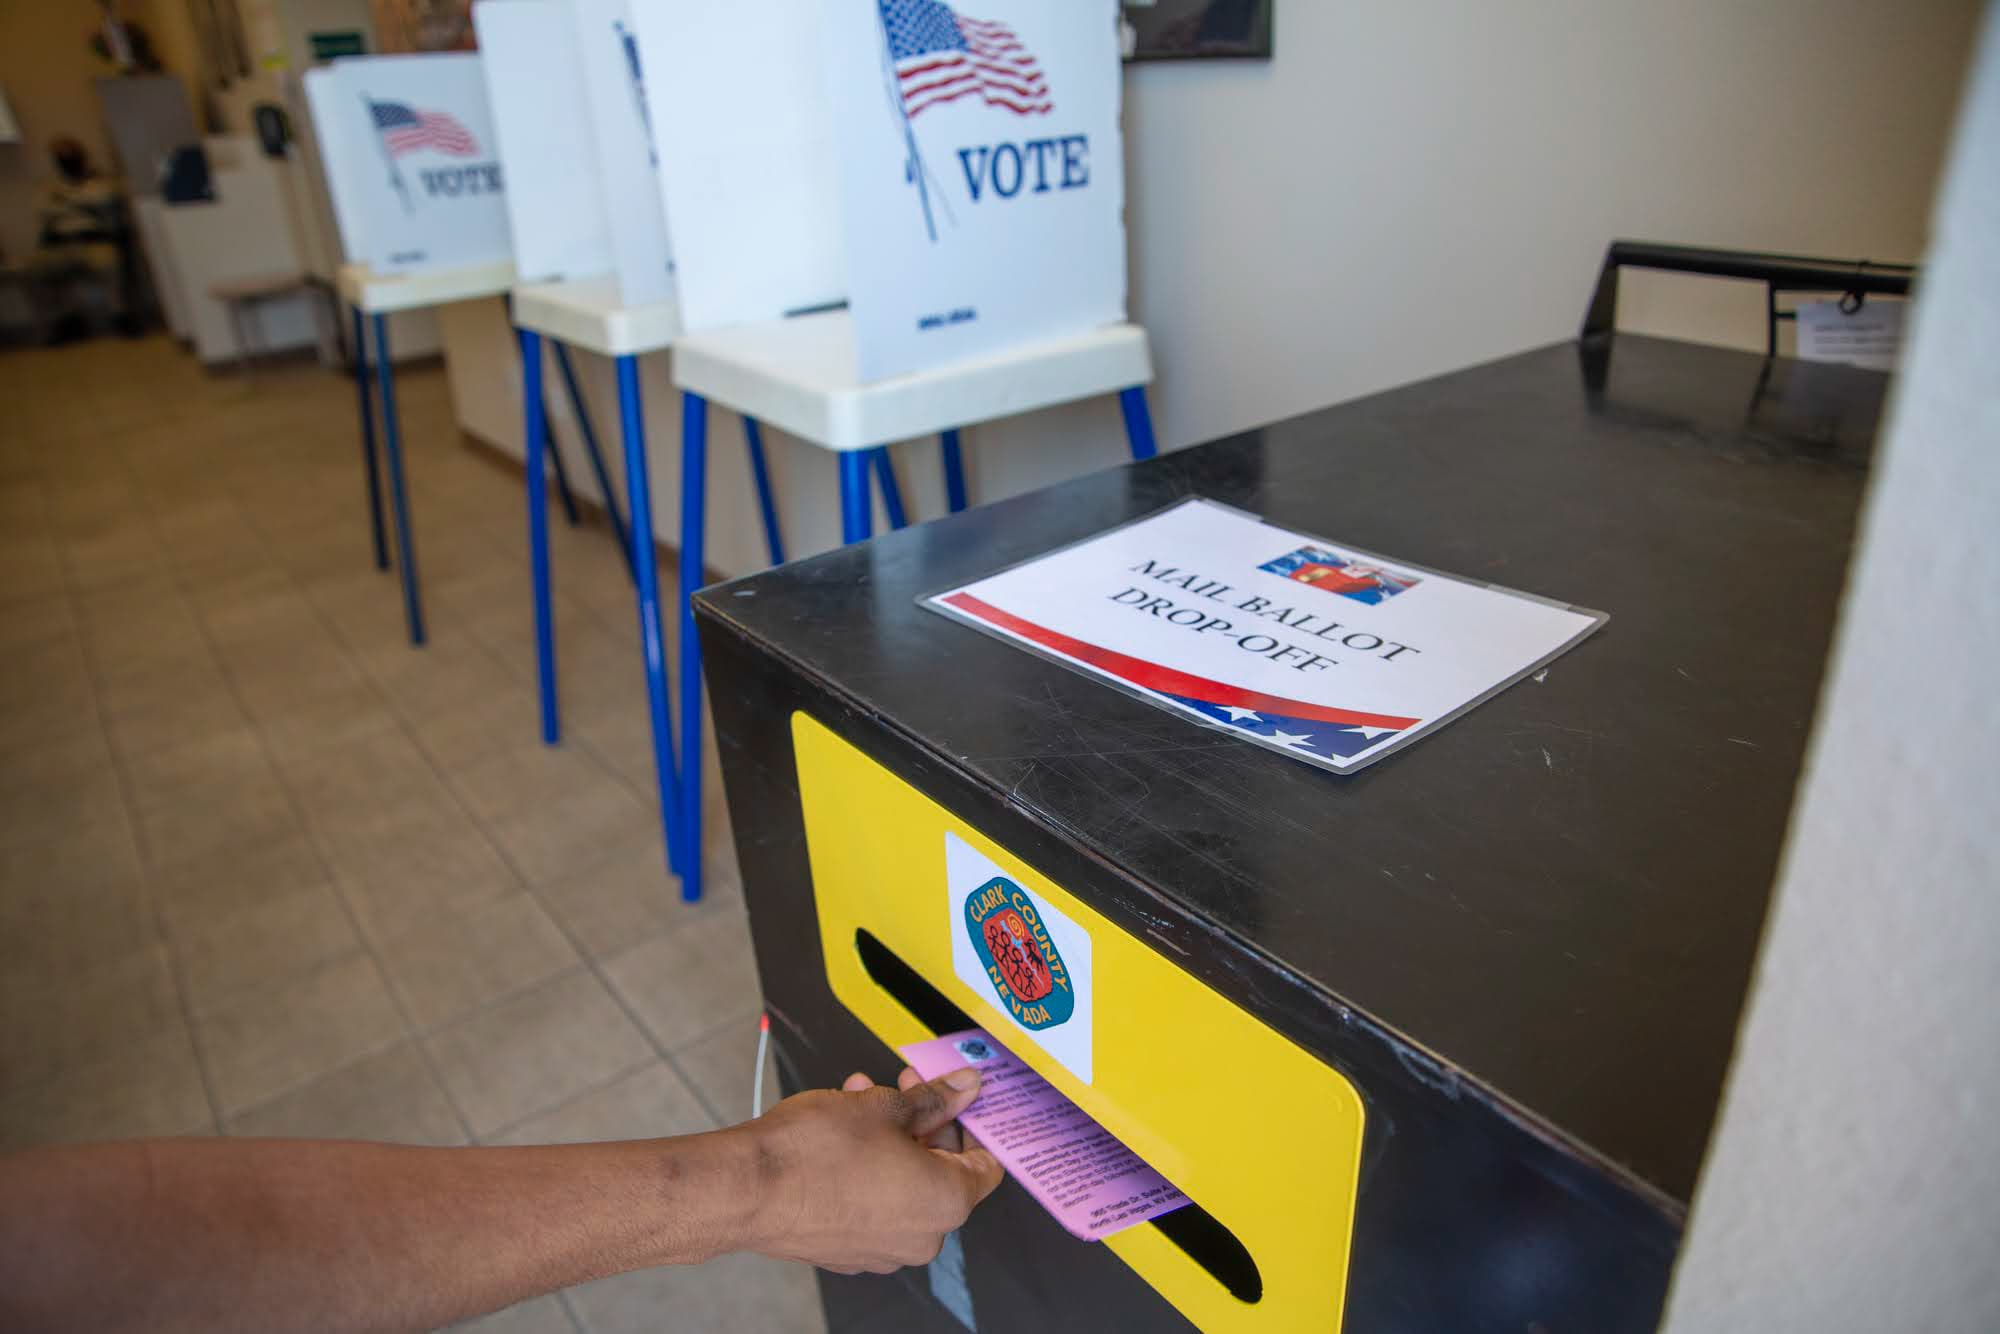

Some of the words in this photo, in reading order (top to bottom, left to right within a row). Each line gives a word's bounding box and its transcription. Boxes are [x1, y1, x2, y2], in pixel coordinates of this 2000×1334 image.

[957, 133, 1090, 203] VOTE
[1106, 587, 1339, 672] DROP-OFF
[1128, 560, 1235, 602] MAIL
[1233, 595, 1422, 661] BALLOT
[970, 885, 1008, 923] CLARK
[1011, 892, 1069, 992] COUNTY
[988, 966, 1052, 1025] NEVADA
